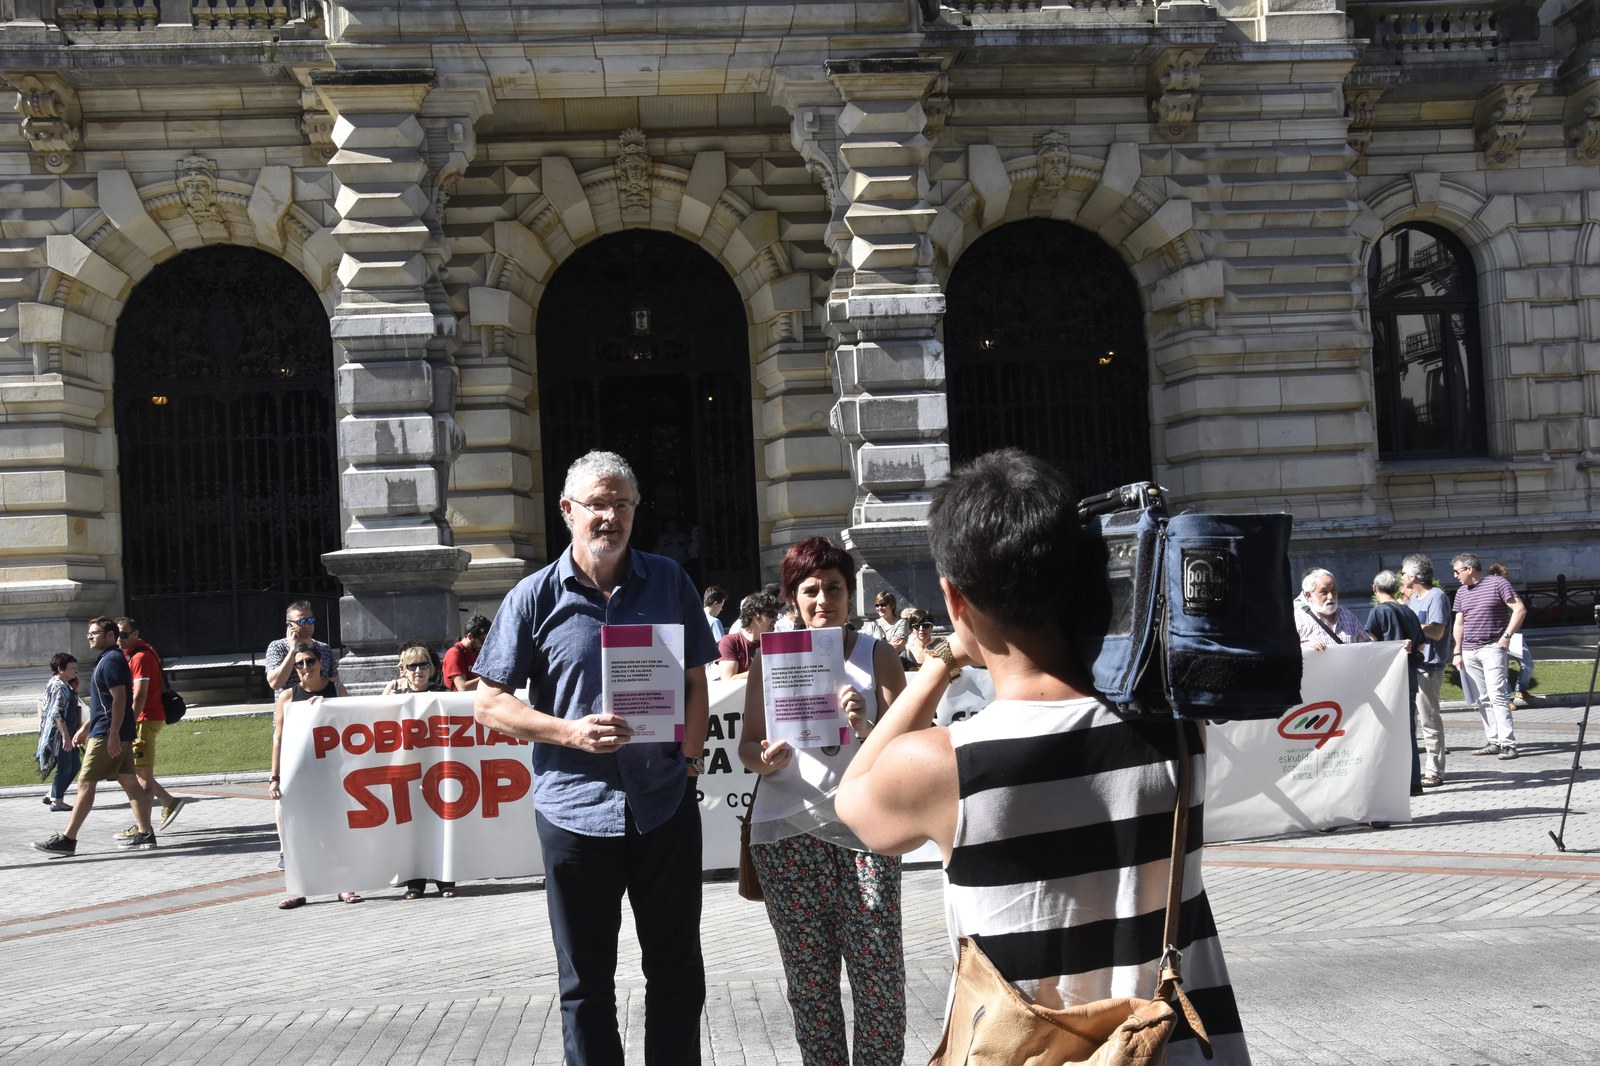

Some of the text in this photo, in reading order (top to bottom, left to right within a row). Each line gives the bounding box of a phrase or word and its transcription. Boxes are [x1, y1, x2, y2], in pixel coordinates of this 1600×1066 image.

[1187, 566, 1222, 583] porta
[313, 715, 528, 759] POBREZIA
[1279, 752, 1313, 764] eskubide
[343, 758, 531, 829] STOP
